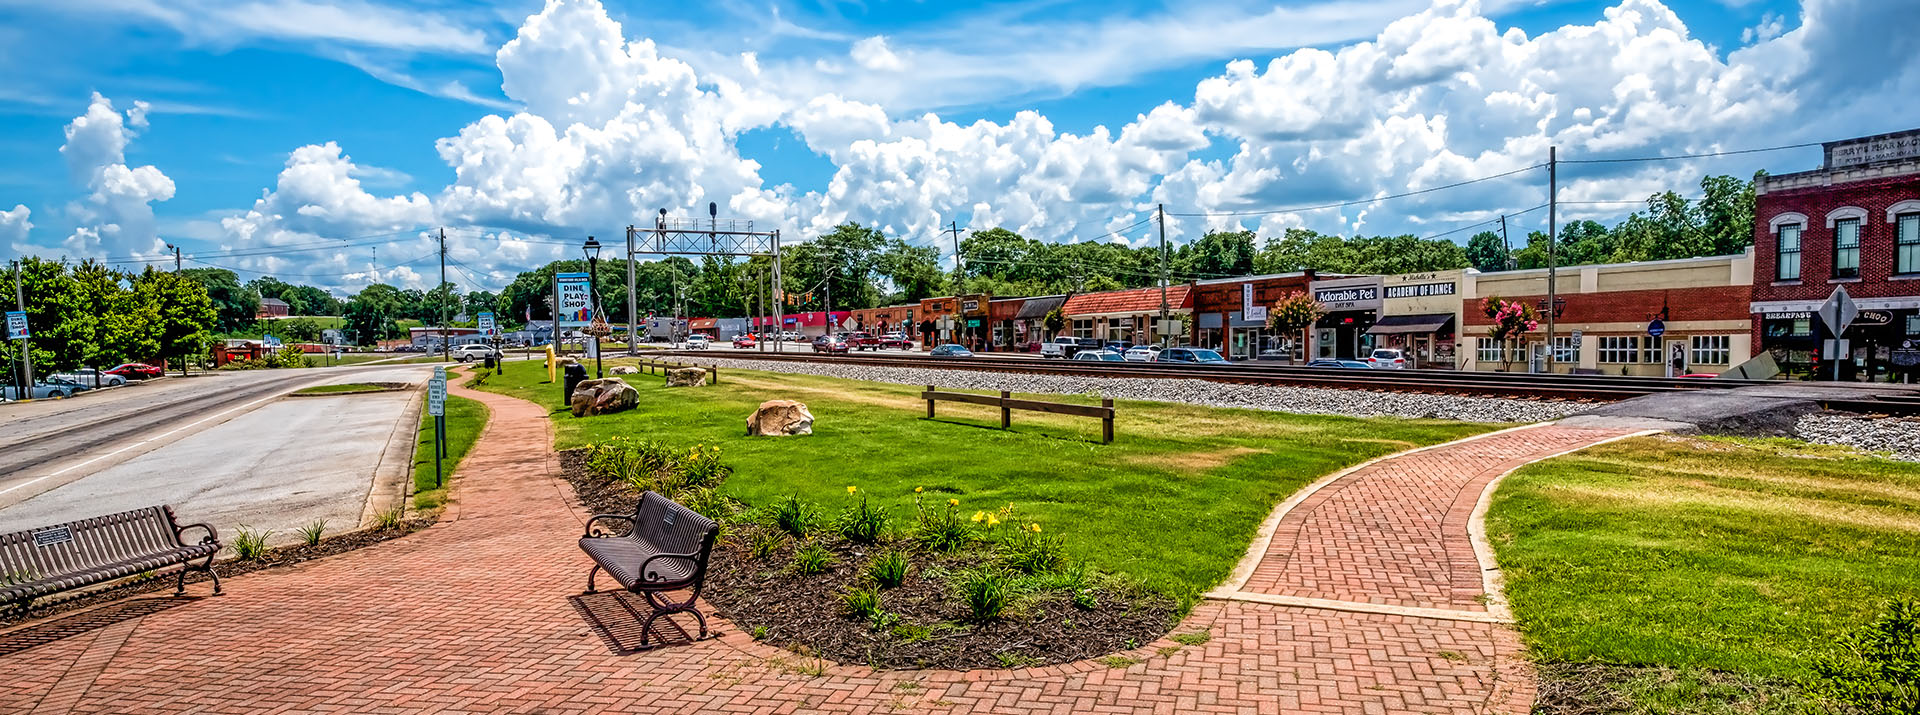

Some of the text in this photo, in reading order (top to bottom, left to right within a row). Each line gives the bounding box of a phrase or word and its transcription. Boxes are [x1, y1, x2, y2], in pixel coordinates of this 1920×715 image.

[1872, 138, 1920, 152] PHARMAC
[1319, 289, 1375, 302] Adorable Pet
[1387, 283, 1452, 298] ACADEMY OF DANCE
[1863, 312, 1887, 322] CHOO
